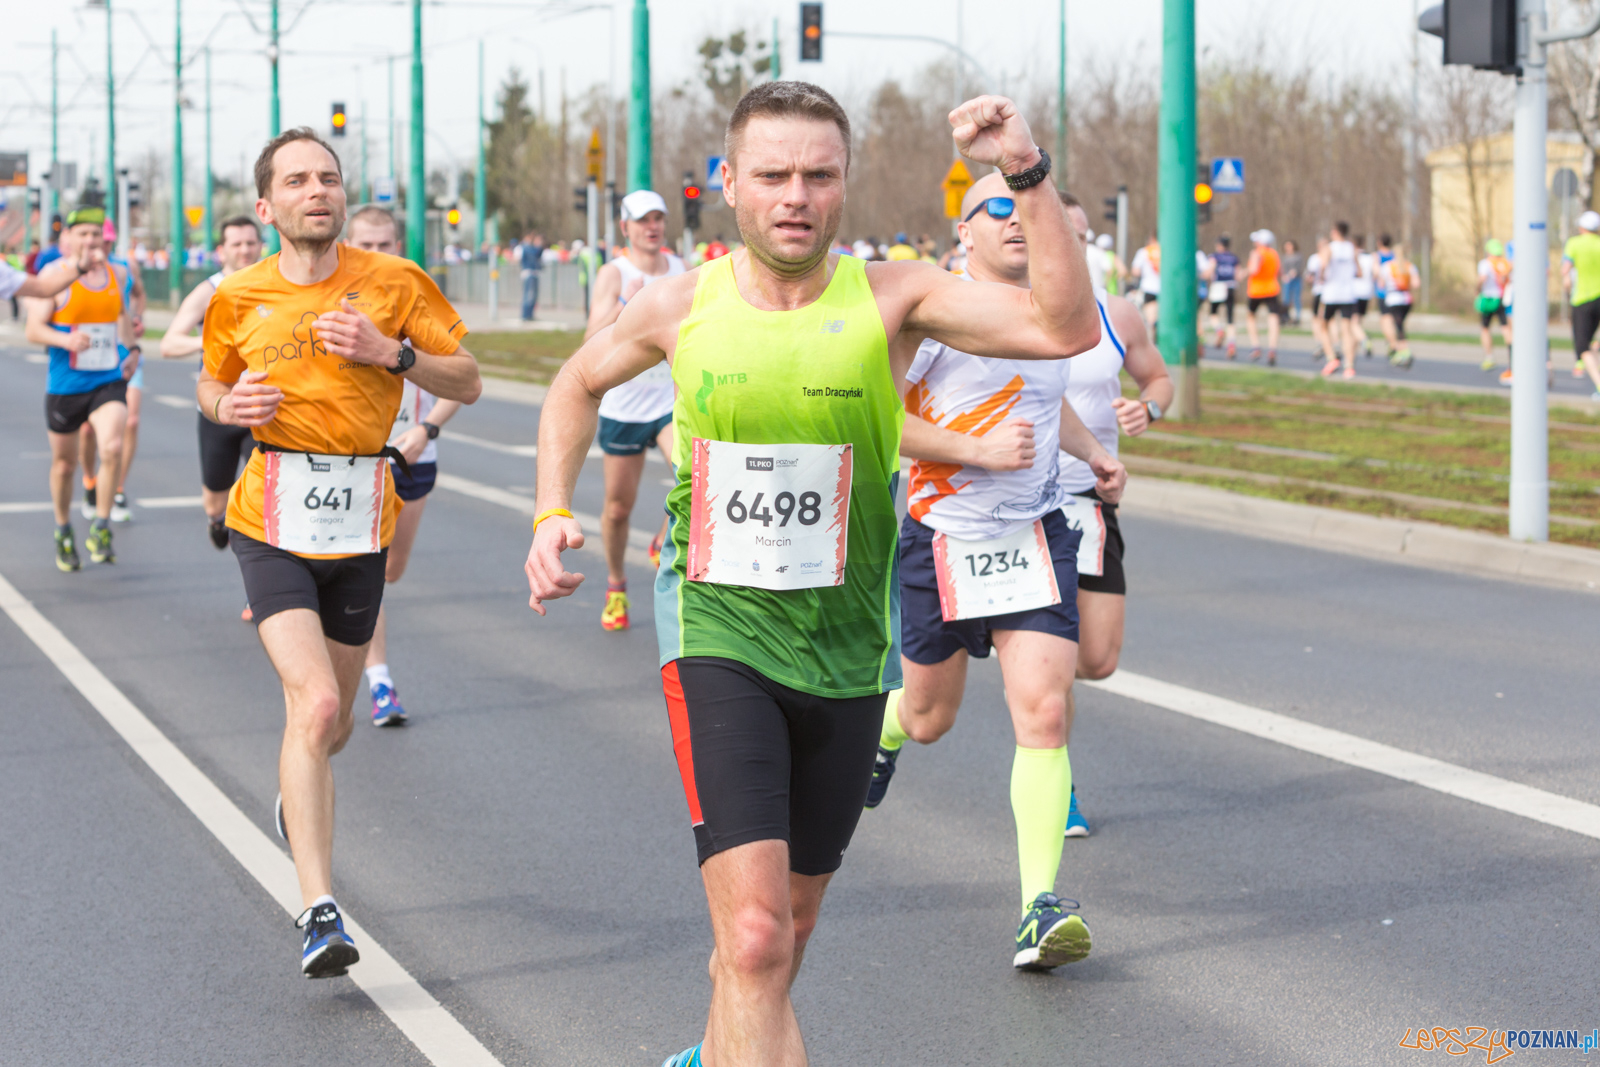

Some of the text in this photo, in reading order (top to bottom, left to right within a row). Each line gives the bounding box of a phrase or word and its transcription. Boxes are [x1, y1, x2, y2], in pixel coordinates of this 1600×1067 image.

[716, 372, 748, 386] MTB
[802, 386, 863, 400] Team Draczyński
[304, 486, 352, 511] 641
[726, 490, 821, 527] 6498
[309, 516, 344, 525] Grzegorz
[755, 535, 792, 547] Marcin
[965, 549, 1029, 576] 1234
